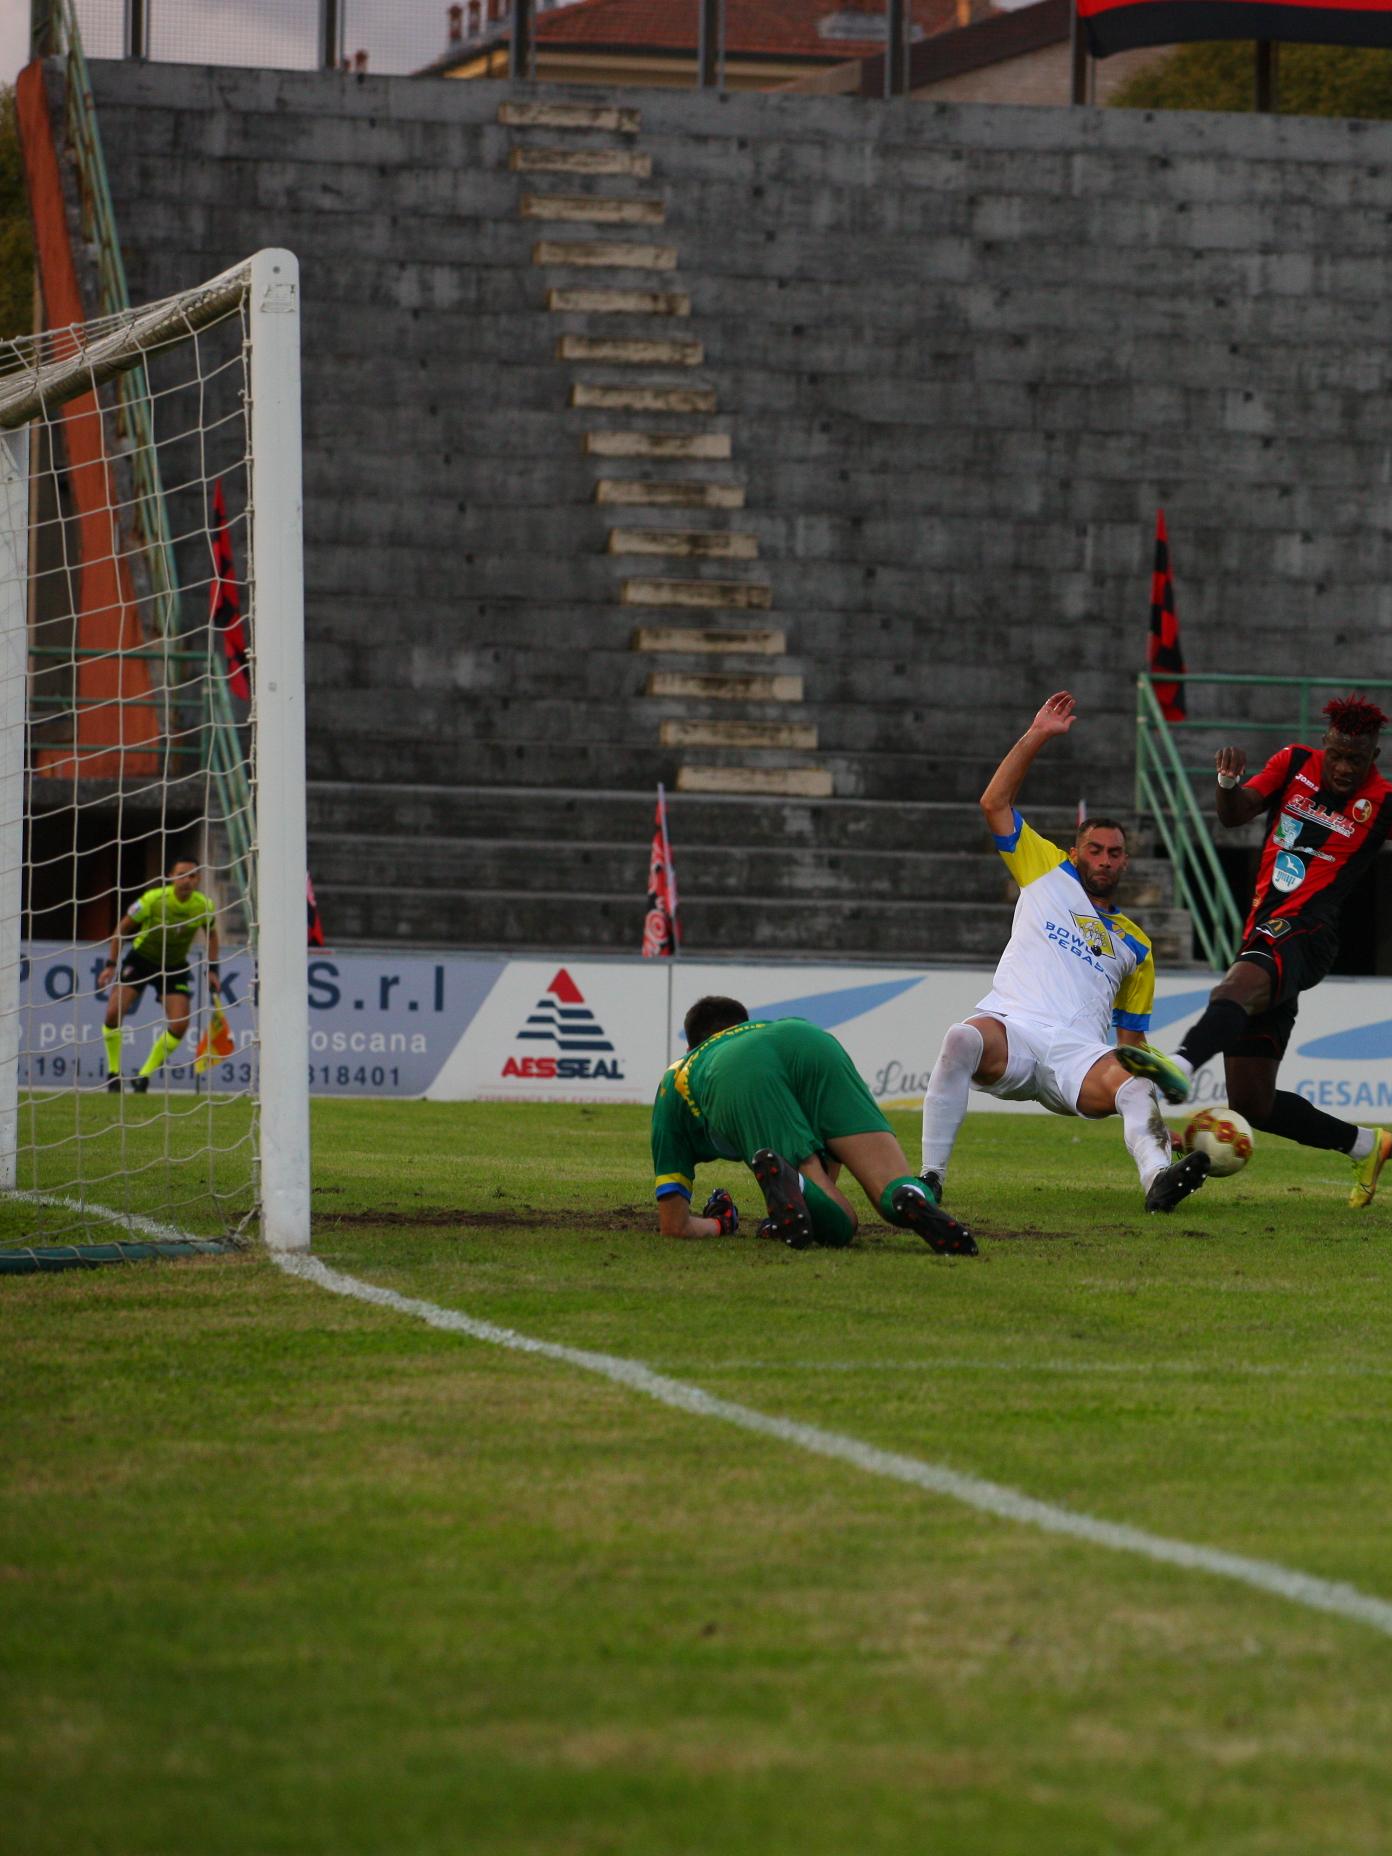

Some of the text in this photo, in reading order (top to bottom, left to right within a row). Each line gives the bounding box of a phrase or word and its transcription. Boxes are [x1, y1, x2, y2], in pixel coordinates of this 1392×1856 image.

[307, 961, 445, 1012] S.r.l
[40, 1022, 92, 1046] per
[307, 1026, 427, 1053] oscana
[502, 1056, 624, 1080] AESSEAL
[874, 1060, 931, 1096] Luc
